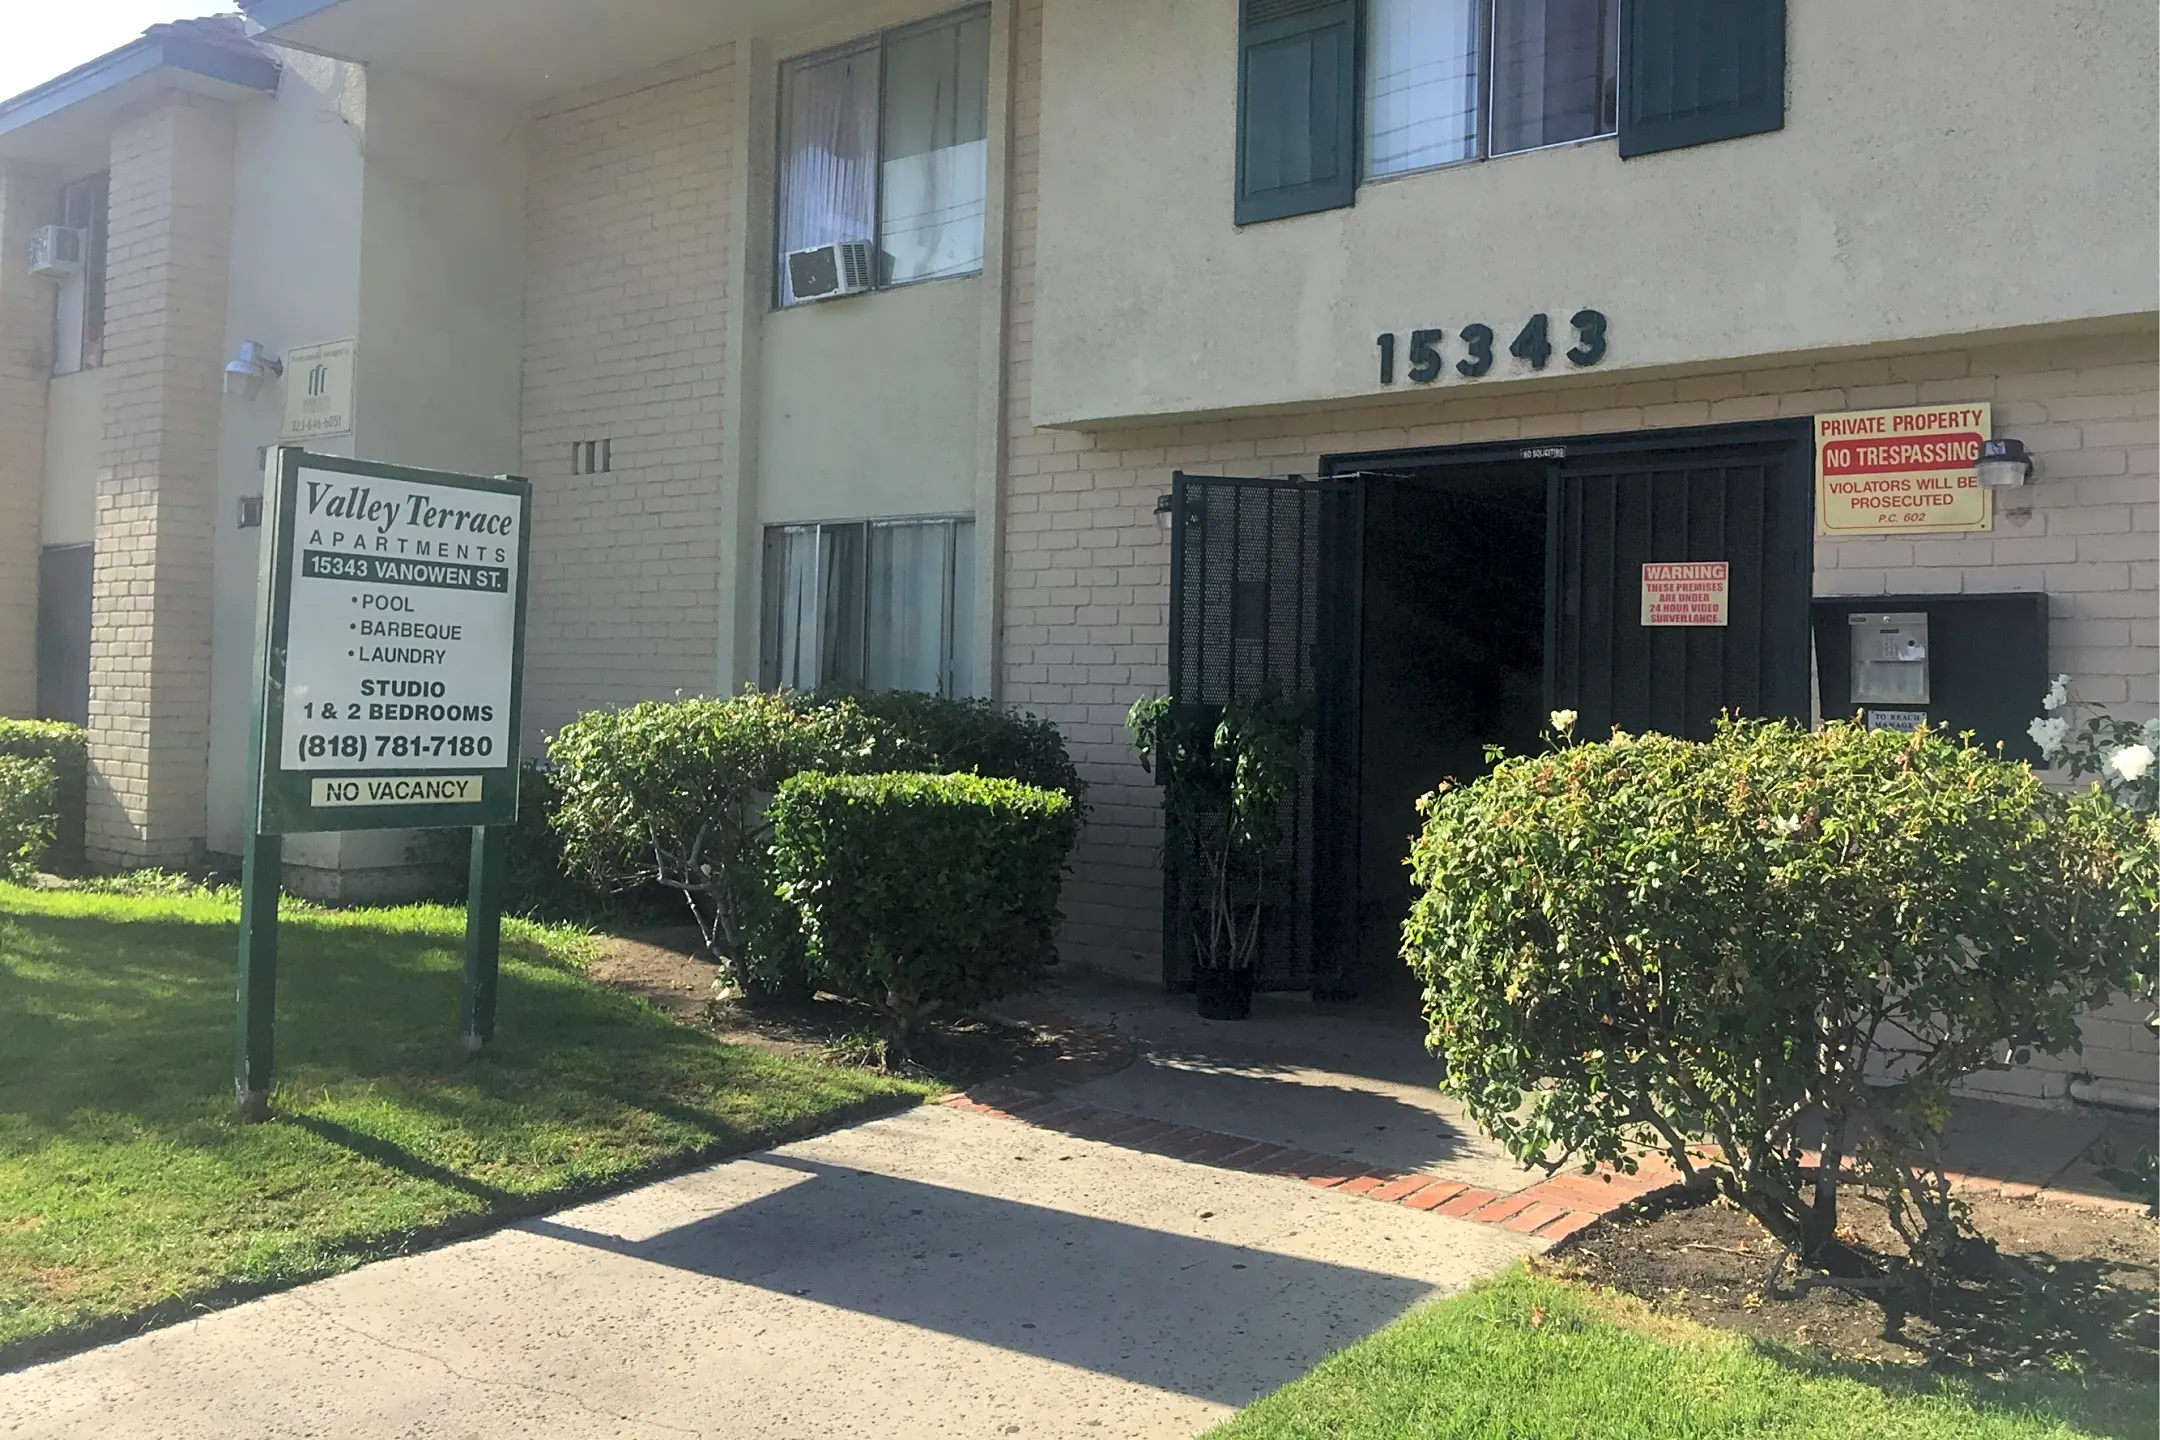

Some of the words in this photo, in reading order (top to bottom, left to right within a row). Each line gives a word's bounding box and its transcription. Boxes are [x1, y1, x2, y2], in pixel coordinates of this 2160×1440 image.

[1376, 309, 1607, 384] 15343
[1821, 416, 1886, 437] PRIVATE
[1893, 409, 1983, 432] PROPERTY
[1523, 450, 1532, 458] NO
[1827, 448, 1851, 468] NO
[1856, 441, 1979, 466] TRESPASSING
[1829, 479, 1911, 494] VIOLATORS
[1916, 478, 1954, 490] WILL
[1957, 476, 1978, 488] BE
[306, 481, 400, 534] Valley
[406, 494, 513, 536] Terrace
[1851, 494, 1954, 508] PROSECUTED
[1878, 514, 1899, 523] P.C.
[1903, 513, 1926, 522] 602
[308, 529, 507, 563] APARTMENTS
[311, 555, 369, 577] 15343
[375, 561, 472, 585] VANOWEN
[476, 569, 503, 588] ST.
[1646, 565, 1725, 580] WARNING
[1647, 583, 1675, 592] THESE
[1676, 582, 1724, 592] PREMISES
[362, 594, 415, 613] POOL
[1659, 593, 1677, 602] ARE
[1679, 593, 1710, 602] UNDER
[1649, 604, 1662, 612] 24
[1663, 604, 1689, 612] HOUR
[1691, 604, 1720, 612] VIDEO
[1650, 614, 1719, 623] SURVEILLANCE
[361, 620, 462, 640] BARBEQUE
[359, 646, 446, 665] LAUNDRY
[360, 679, 446, 698] STUDIO
[304, 702, 313, 719] 1
[321, 703, 338, 720] &
[347, 703, 361, 720] 2
[369, 703, 494, 722] BEDROOMS
[1875, 713, 1887, 721] TO
[298, 734, 368, 762] (818)
[375, 735, 493, 758] 781-7180
[326, 782, 360, 802] NO
[367, 780, 469, 800] VACANCY
